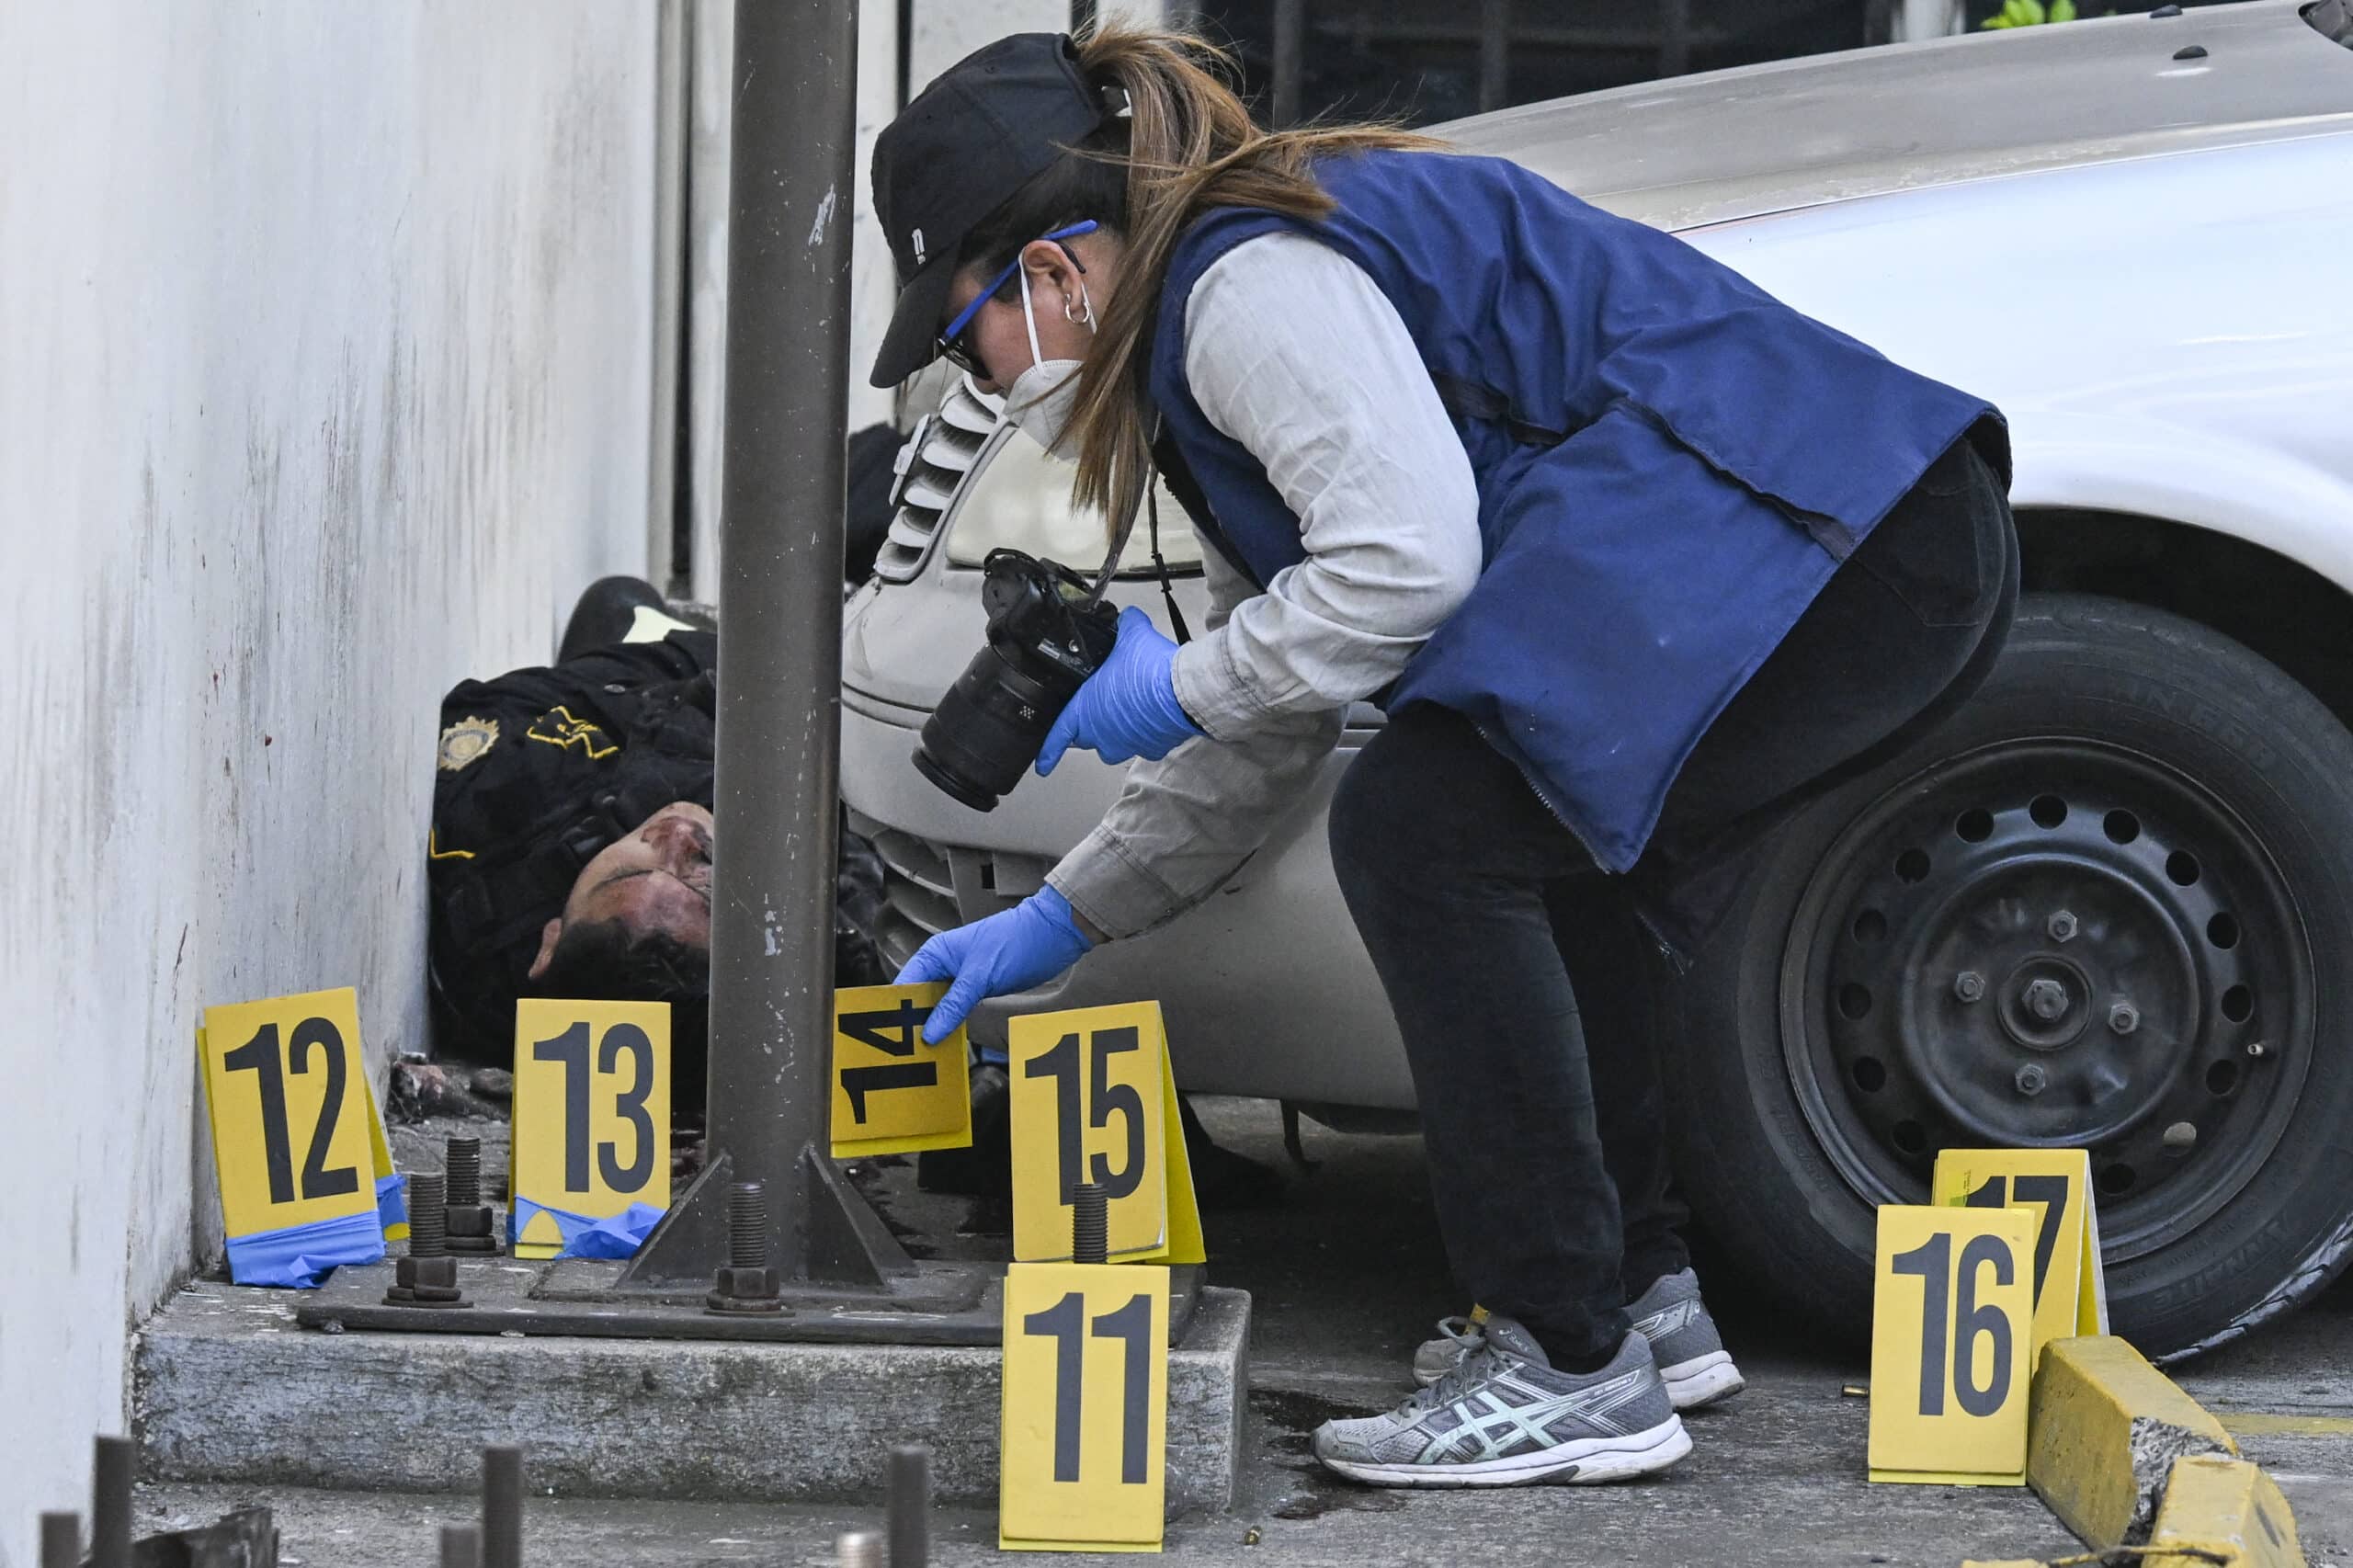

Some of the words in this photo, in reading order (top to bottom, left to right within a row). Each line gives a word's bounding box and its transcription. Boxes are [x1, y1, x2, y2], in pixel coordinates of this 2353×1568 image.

[226, 1019, 358, 1203] 12
[535, 1023, 654, 1193] 13
[838, 998, 937, 1124] 14
[1026, 1027, 1145, 1206] 15
[1025, 1293, 1152, 1483] 11
[1893, 1233, 2014, 1416] 16
